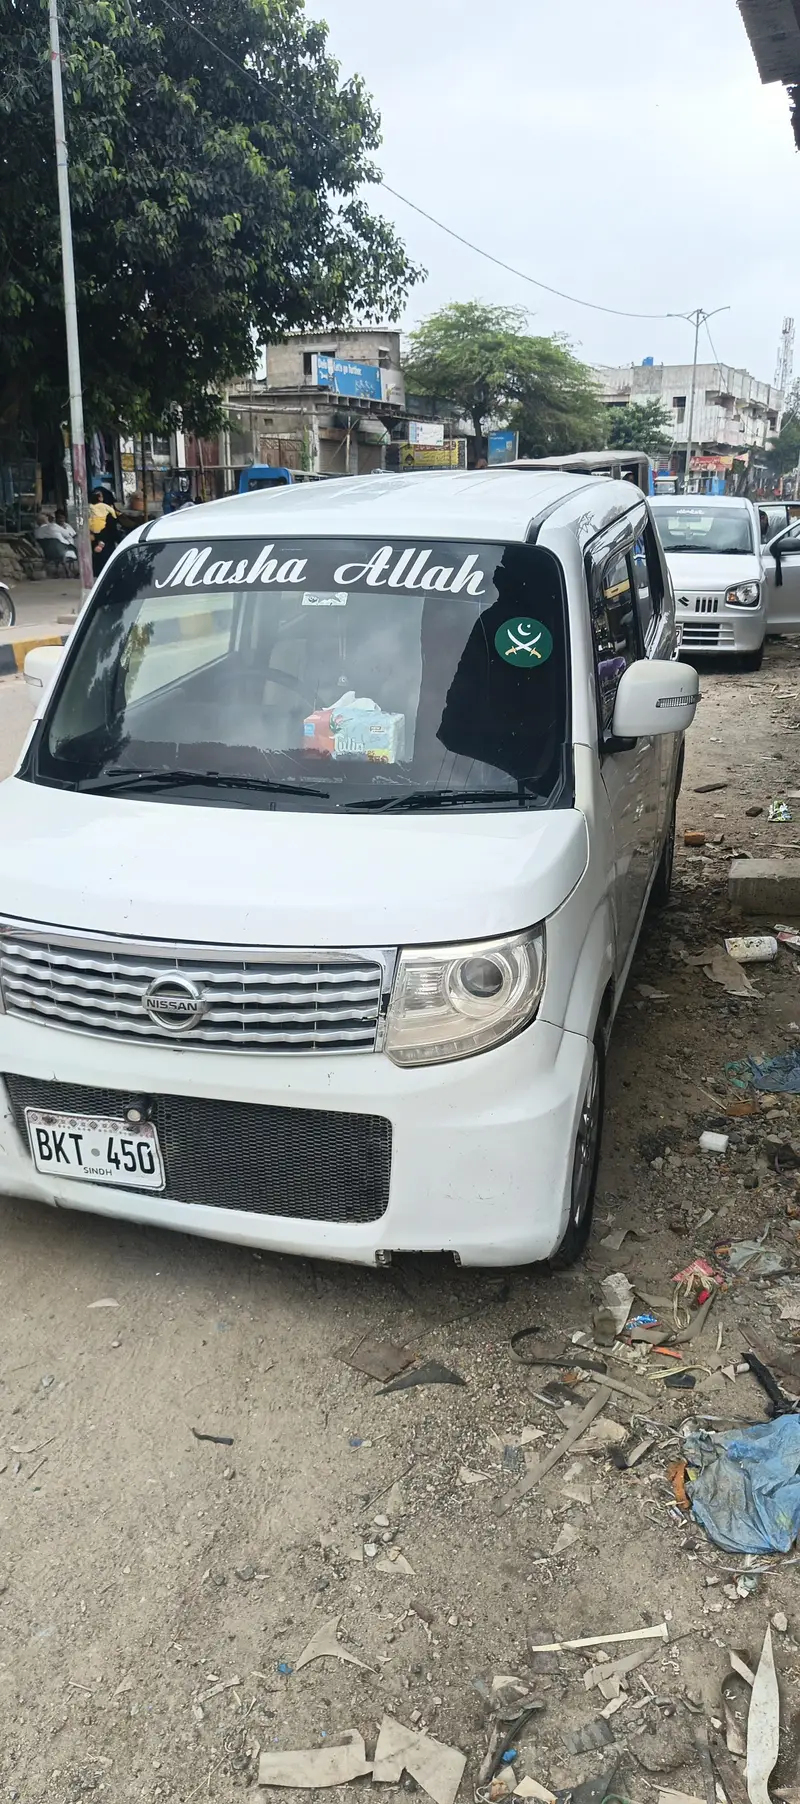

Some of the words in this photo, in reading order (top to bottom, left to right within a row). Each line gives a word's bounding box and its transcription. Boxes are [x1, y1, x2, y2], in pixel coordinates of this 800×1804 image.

[155, 543, 308, 588] Masha
[334, 545, 486, 596] Allah
[146, 999, 198, 1011] NISSAN
[35, 1127, 84, 1166] BKT
[107, 1136, 155, 1175] 450
[83, 1166, 113, 1176] SINDH
